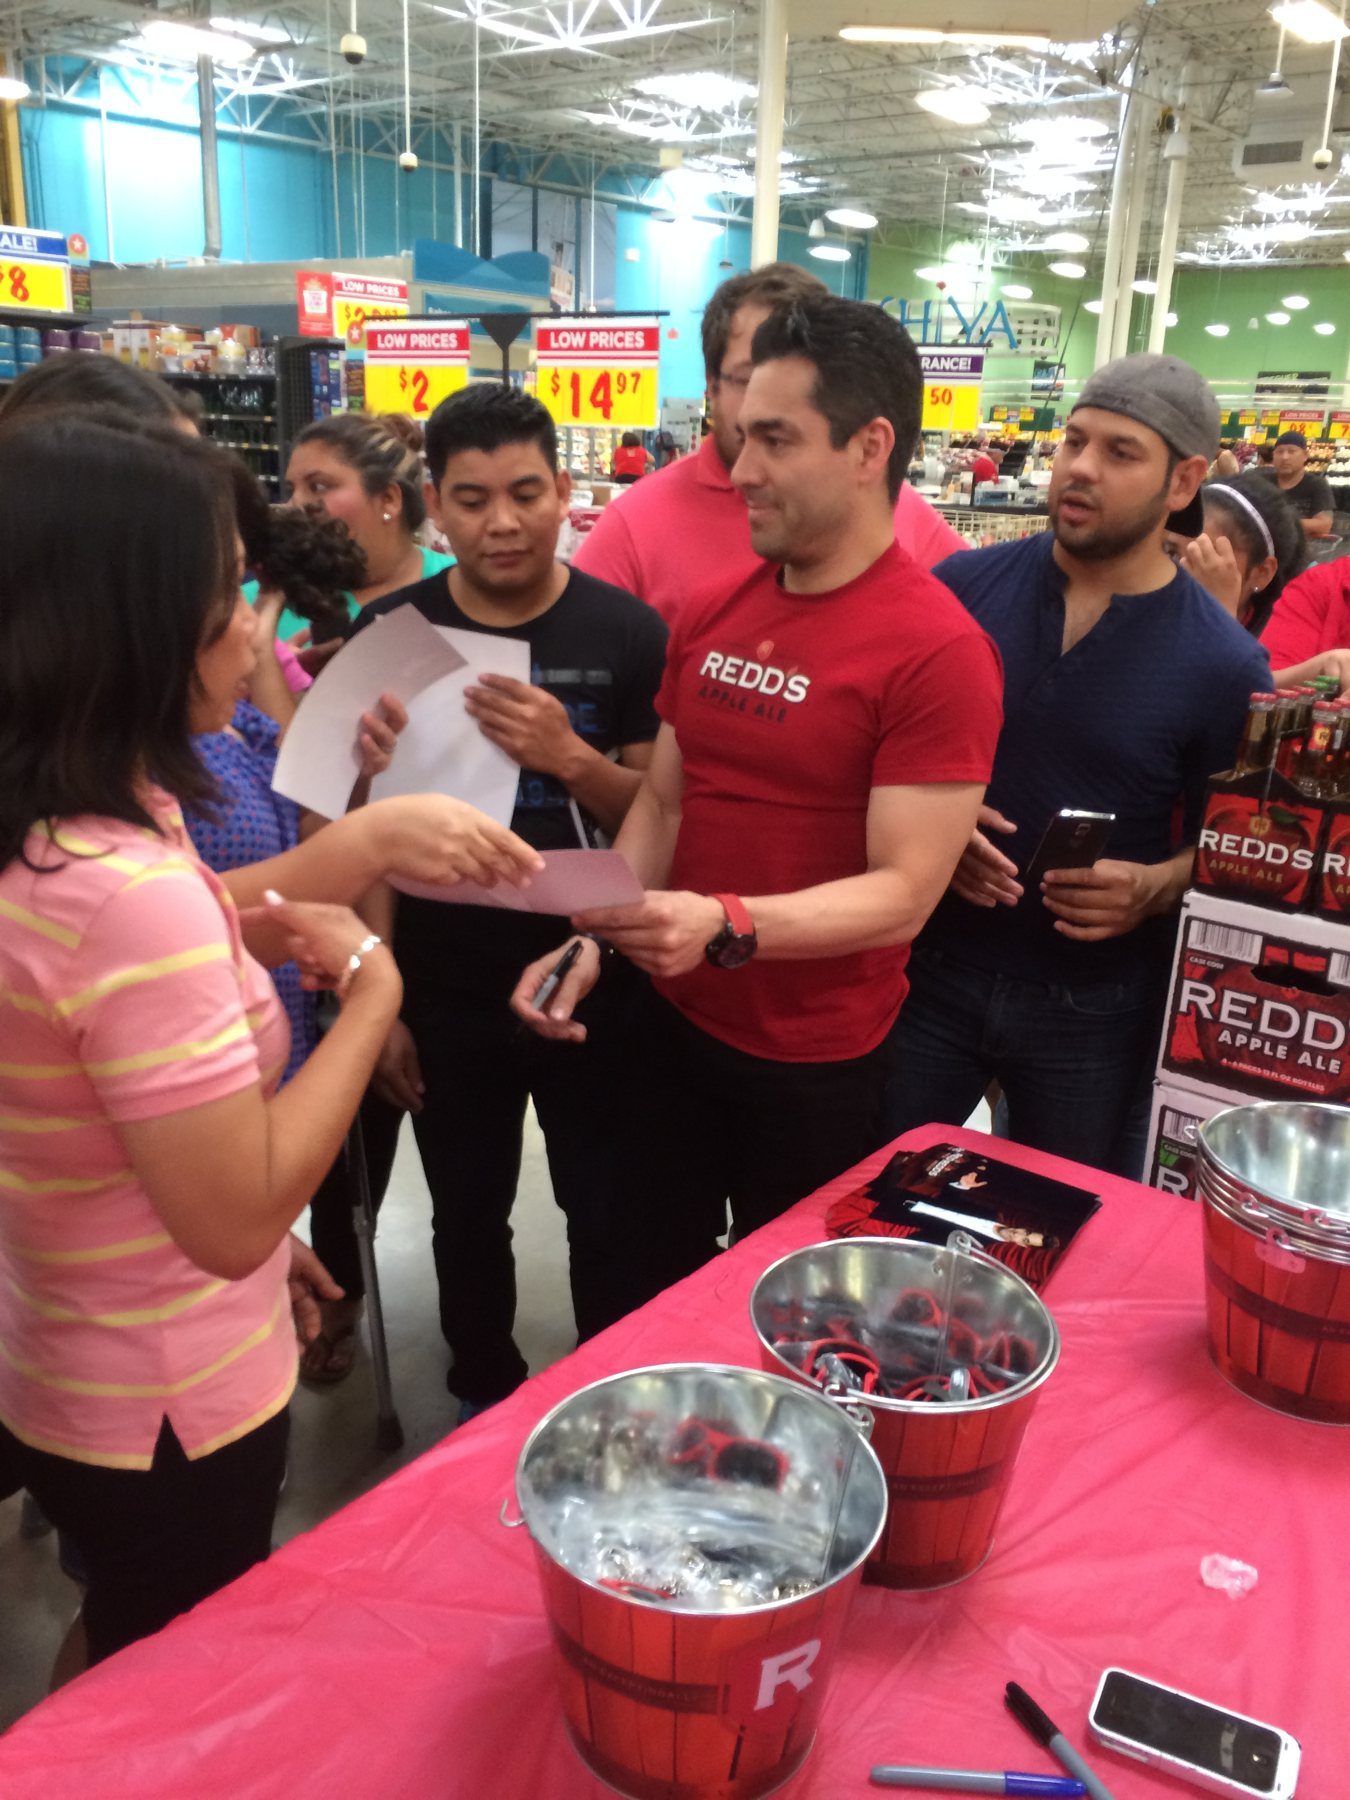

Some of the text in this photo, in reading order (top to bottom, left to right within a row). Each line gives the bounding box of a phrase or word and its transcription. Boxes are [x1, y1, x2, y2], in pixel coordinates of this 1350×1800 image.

[0, 232, 38, 252] ALE!
[342, 280, 400, 296] LOW PRICES
[377, 332, 458, 348] LOW PRICES
[550, 331, 645, 348] LOW PRICES
[921, 357, 972, 371] RANCE!
[698, 685, 787, 723] APPLE ALE
[1209, 859, 1283, 883] APPLE ALE
[1322, 852, 1350, 877] R
[1179, 979, 1350, 1051] REDD
[1218, 1029, 1342, 1074] APPLE ALE
[753, 1638, 822, 1711] R
